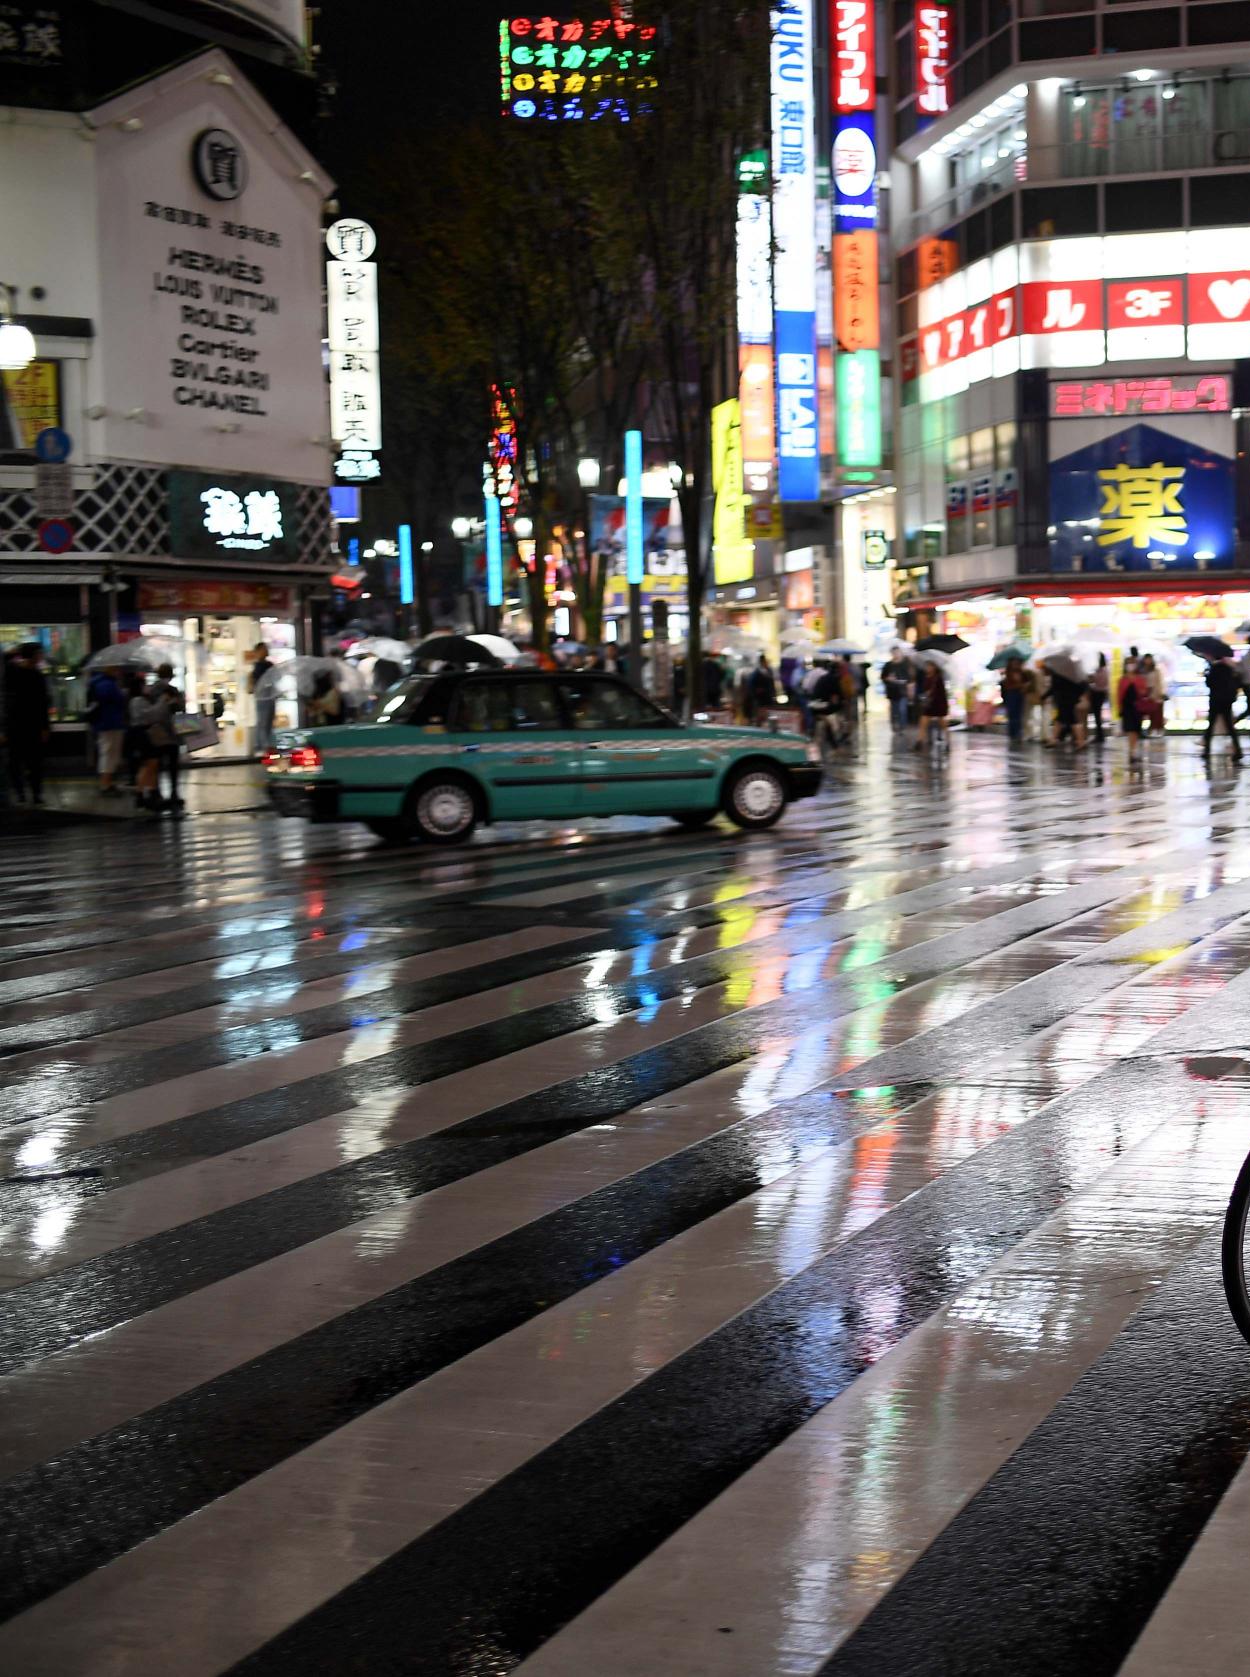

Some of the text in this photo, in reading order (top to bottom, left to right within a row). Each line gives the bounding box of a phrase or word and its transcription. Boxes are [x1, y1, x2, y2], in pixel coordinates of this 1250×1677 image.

[836, 1, 870, 106] アイフル
[168, 247, 266, 285] HERMÈS
[153, 271, 280, 315] LOUIS VUITTON
[181, 304, 257, 336] ROLEX
[947, 287, 1172, 358] アイフル 3F
[177, 333, 261, 364] Cartier
[169, 358, 271, 392] BVLGARI
[173, 386, 268, 416] CHANEL
[780, 388, 816, 457] LABI
[1096, 462, 1189, 548] 薬
